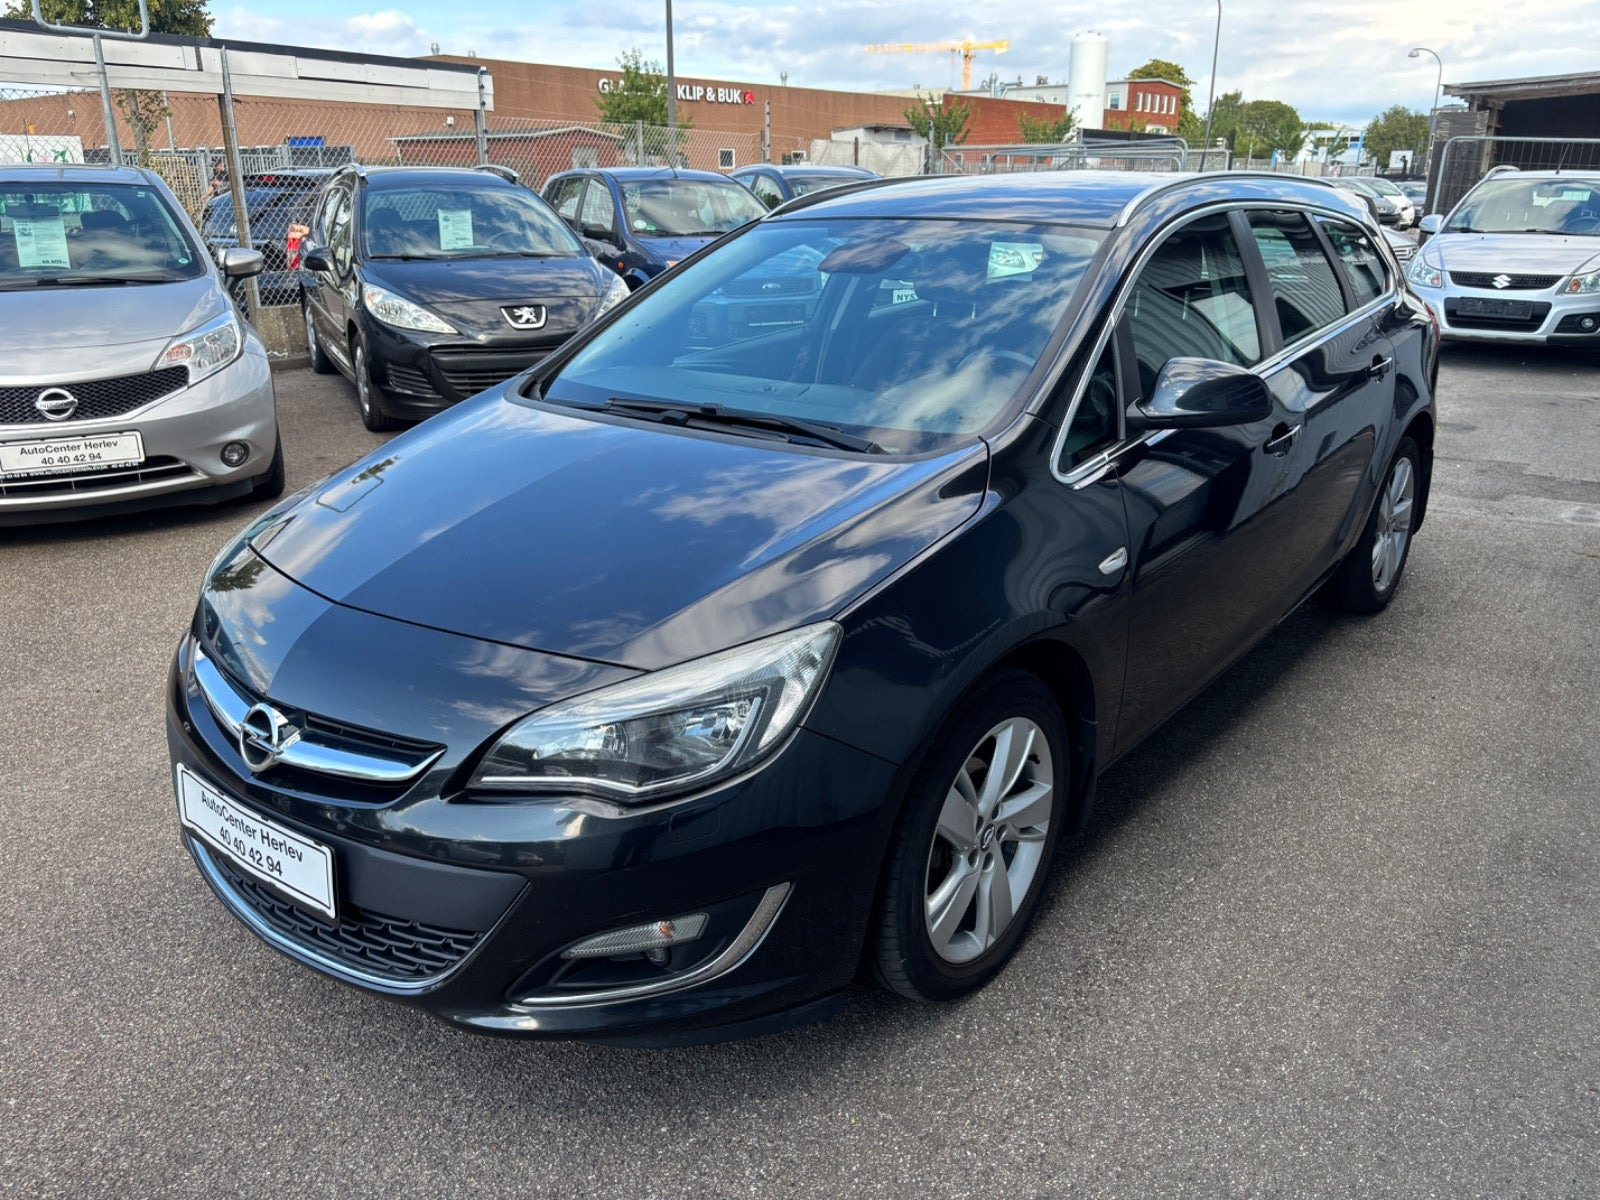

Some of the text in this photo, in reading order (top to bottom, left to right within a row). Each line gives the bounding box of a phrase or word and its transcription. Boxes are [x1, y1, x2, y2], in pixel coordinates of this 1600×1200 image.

[677, 84, 704, 101] KLIP
[706, 86, 716, 102] &
[718, 87, 742, 104] BUK
[896, 292, 915, 301] NYS
[20, 439, 118, 455] AutoCenter Herlev
[41, 452, 102, 465] 40 40 42 94
[201, 790, 303, 863] AutoCenter Herlev
[219, 826, 283, 876] 40 40 42 94
